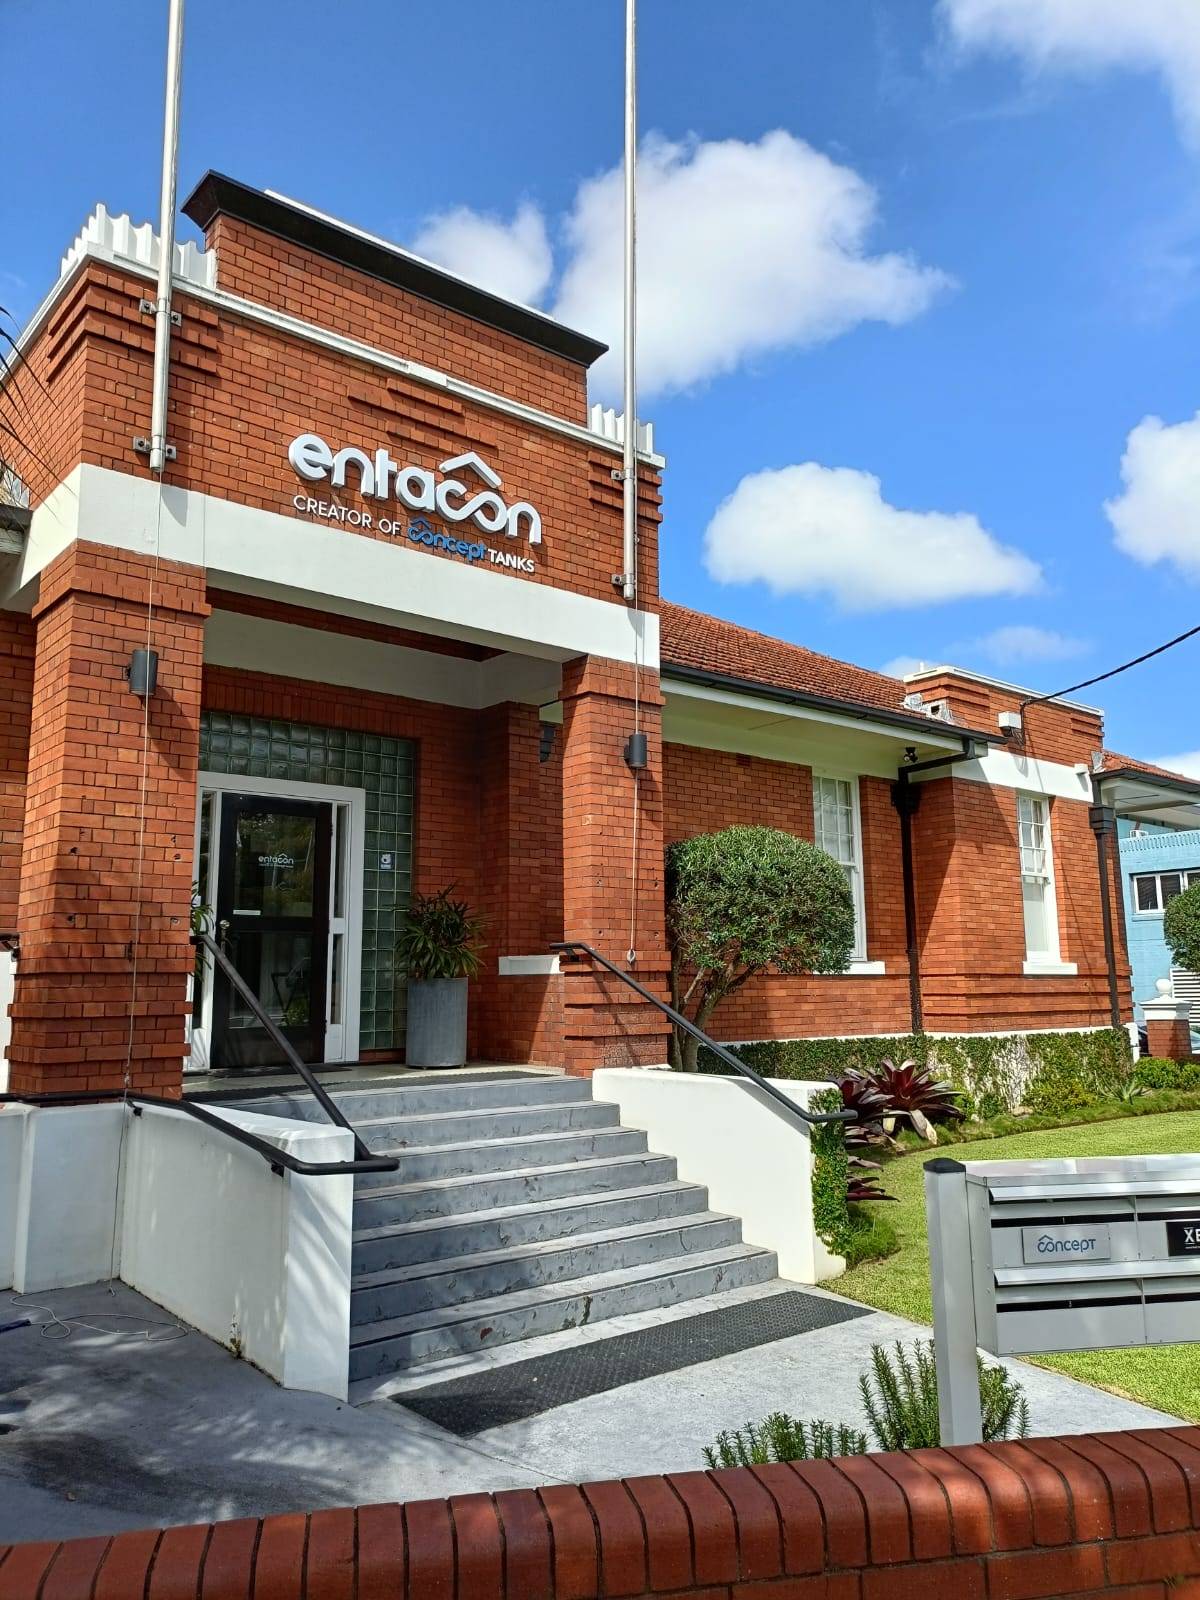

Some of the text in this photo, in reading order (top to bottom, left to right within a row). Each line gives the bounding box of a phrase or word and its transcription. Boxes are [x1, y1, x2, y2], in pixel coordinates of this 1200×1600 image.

[288, 433, 542, 546] entacon
[293, 495, 372, 528] CREATOR
[378, 518, 402, 535] OF
[487, 548, 535, 573] TANKS
